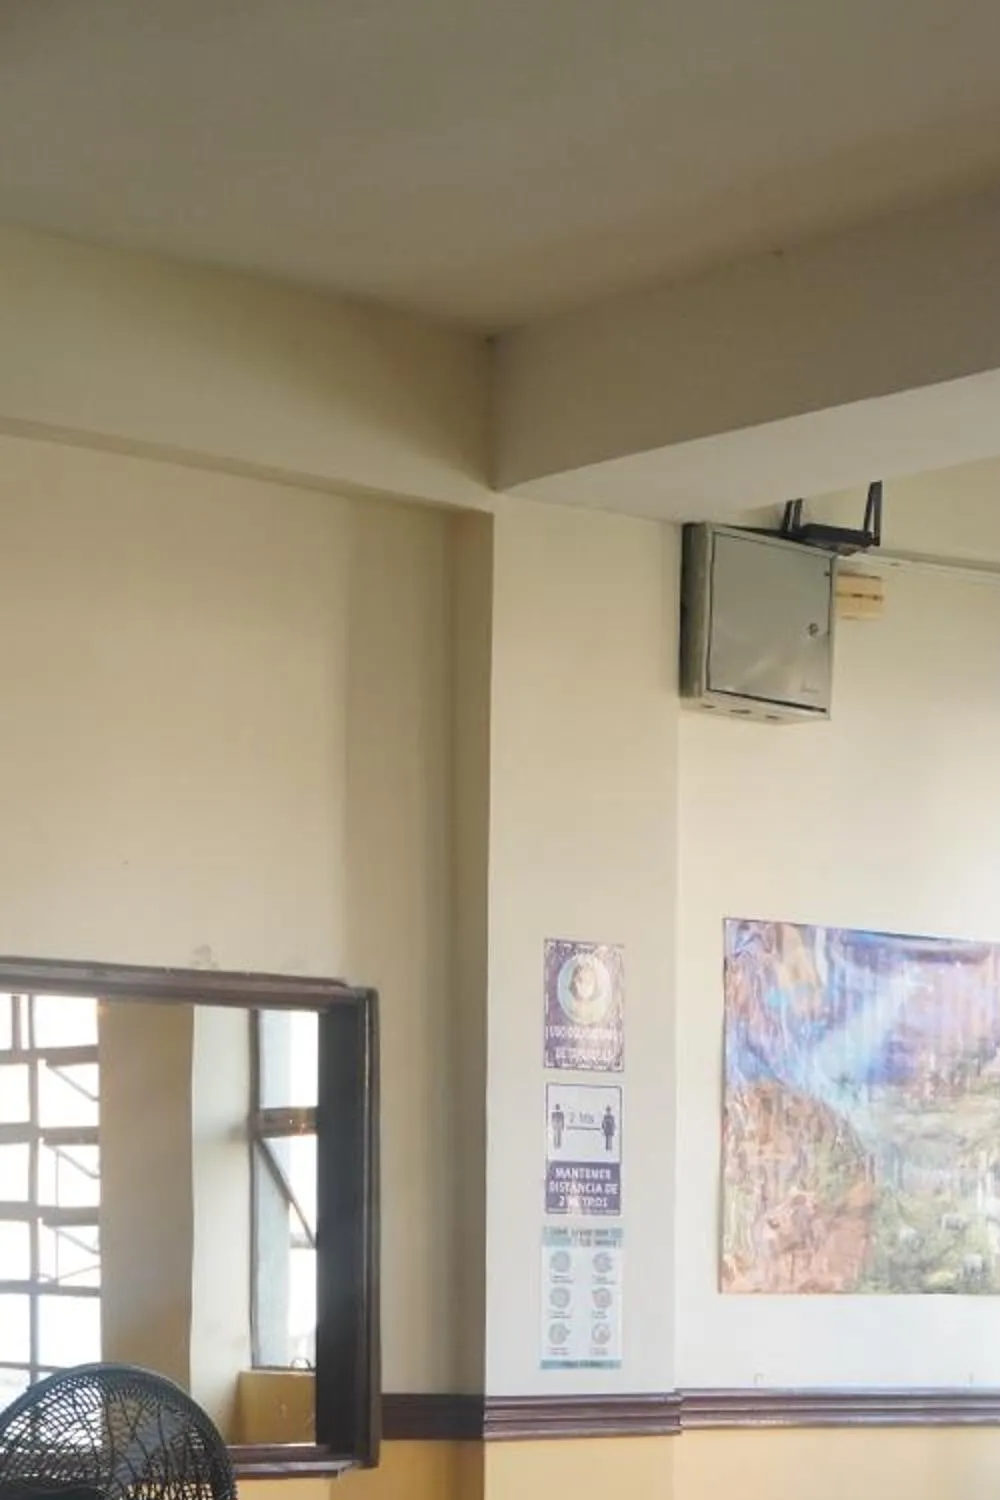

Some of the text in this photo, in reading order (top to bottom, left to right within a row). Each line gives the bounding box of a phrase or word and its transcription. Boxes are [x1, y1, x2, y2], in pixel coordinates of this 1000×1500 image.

[555, 1167, 612, 1180] MANTENER
[549, 1181, 619, 1195] DISTANCIA DE
[559, 1195, 608, 1208] 2 MTROS
